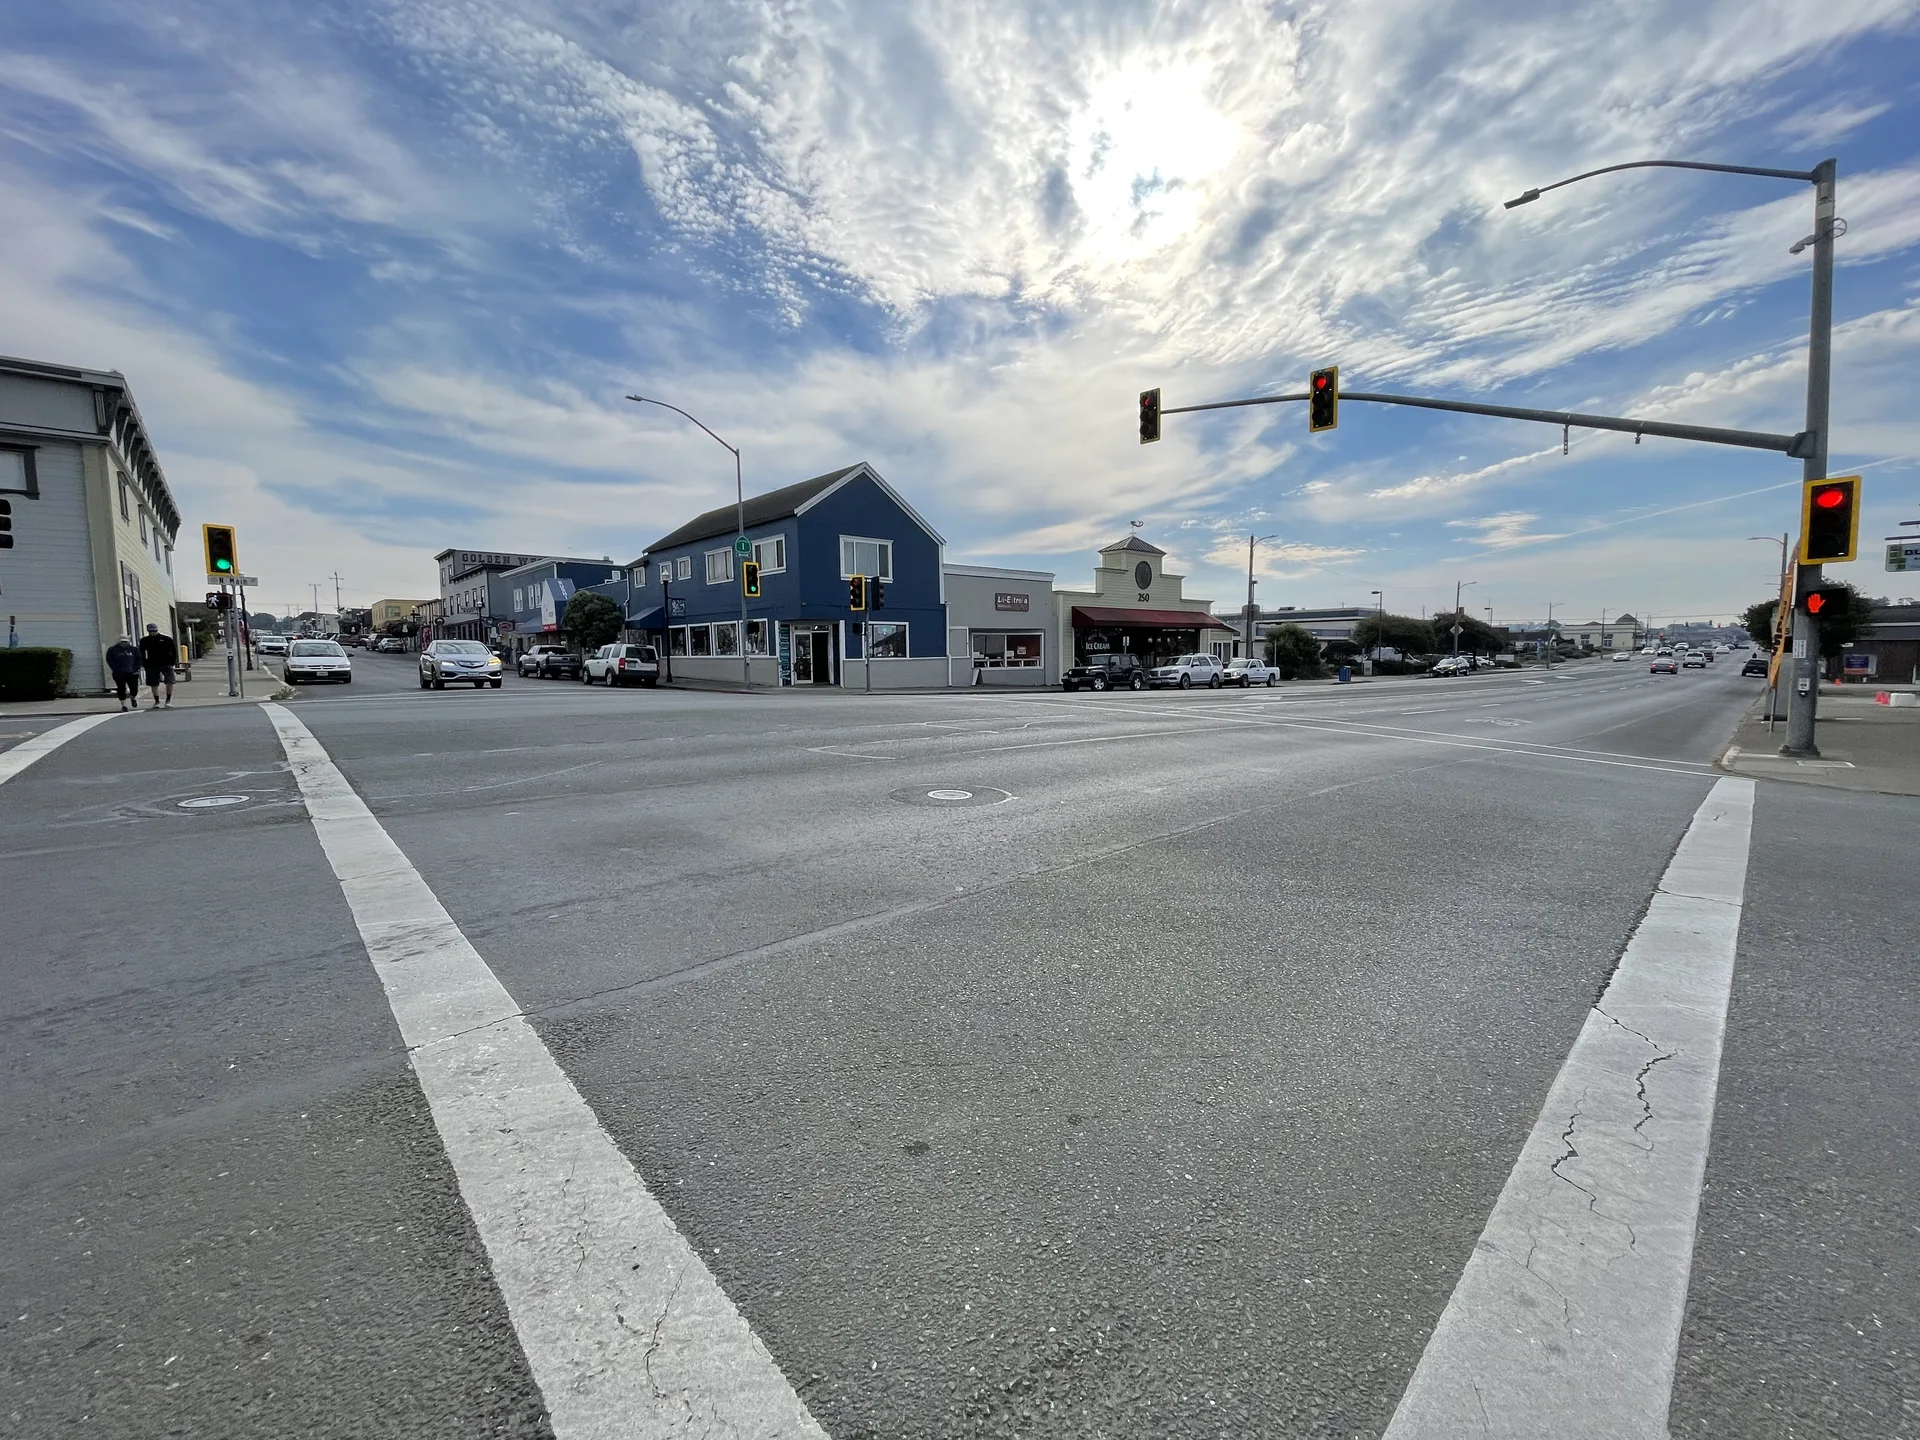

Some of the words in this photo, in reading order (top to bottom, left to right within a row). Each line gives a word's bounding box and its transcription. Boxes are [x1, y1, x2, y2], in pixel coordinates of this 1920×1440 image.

[461, 553, 510, 564] GOLDEN
[517, 556, 545, 565] WE
[229, 577, 248, 585] Main
[1137, 592, 1150, 602] 250
[1085, 642, 1093, 650] ICE
[1093, 641, 1110, 650] CREAM
